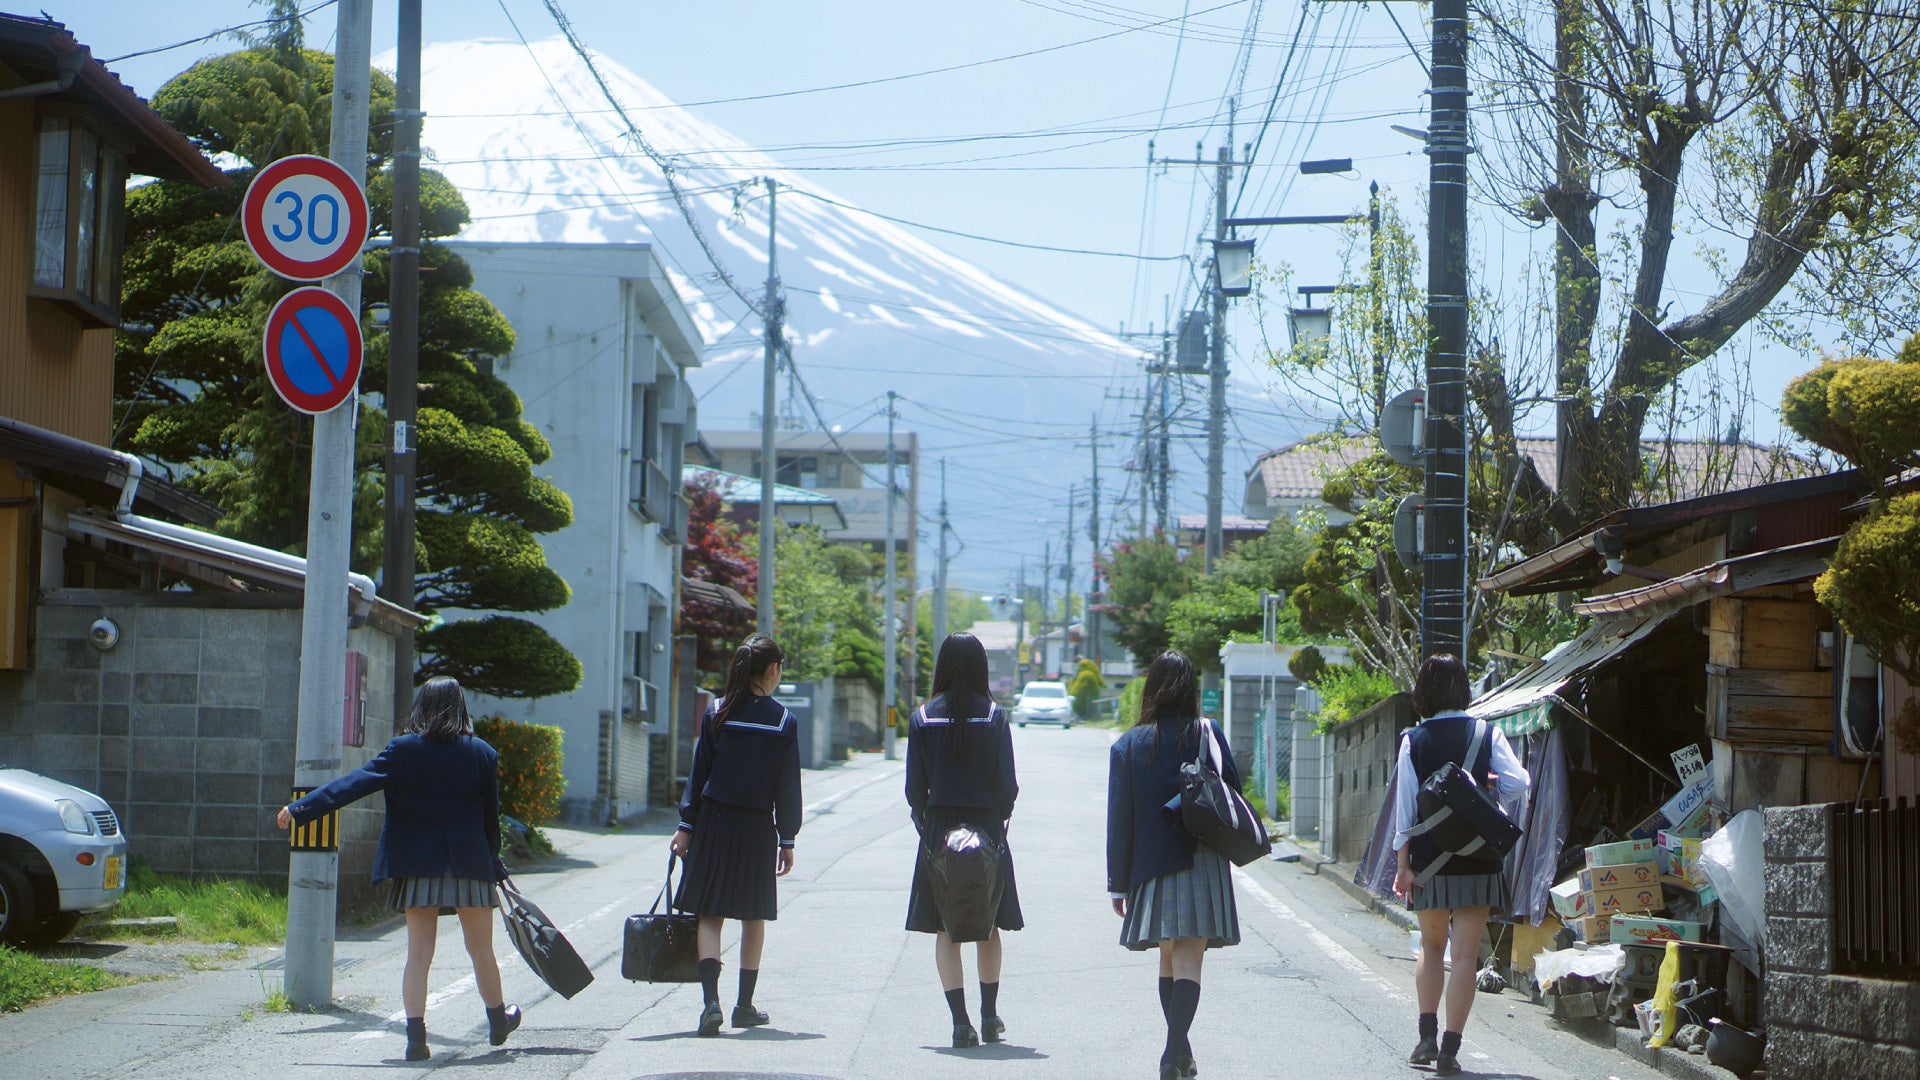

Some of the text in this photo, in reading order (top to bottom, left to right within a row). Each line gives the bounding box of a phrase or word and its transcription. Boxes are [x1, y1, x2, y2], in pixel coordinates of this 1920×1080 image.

[272, 190, 339, 245] 30
[1599, 870, 1618, 882] JA
[1602, 894, 1621, 906] JA
